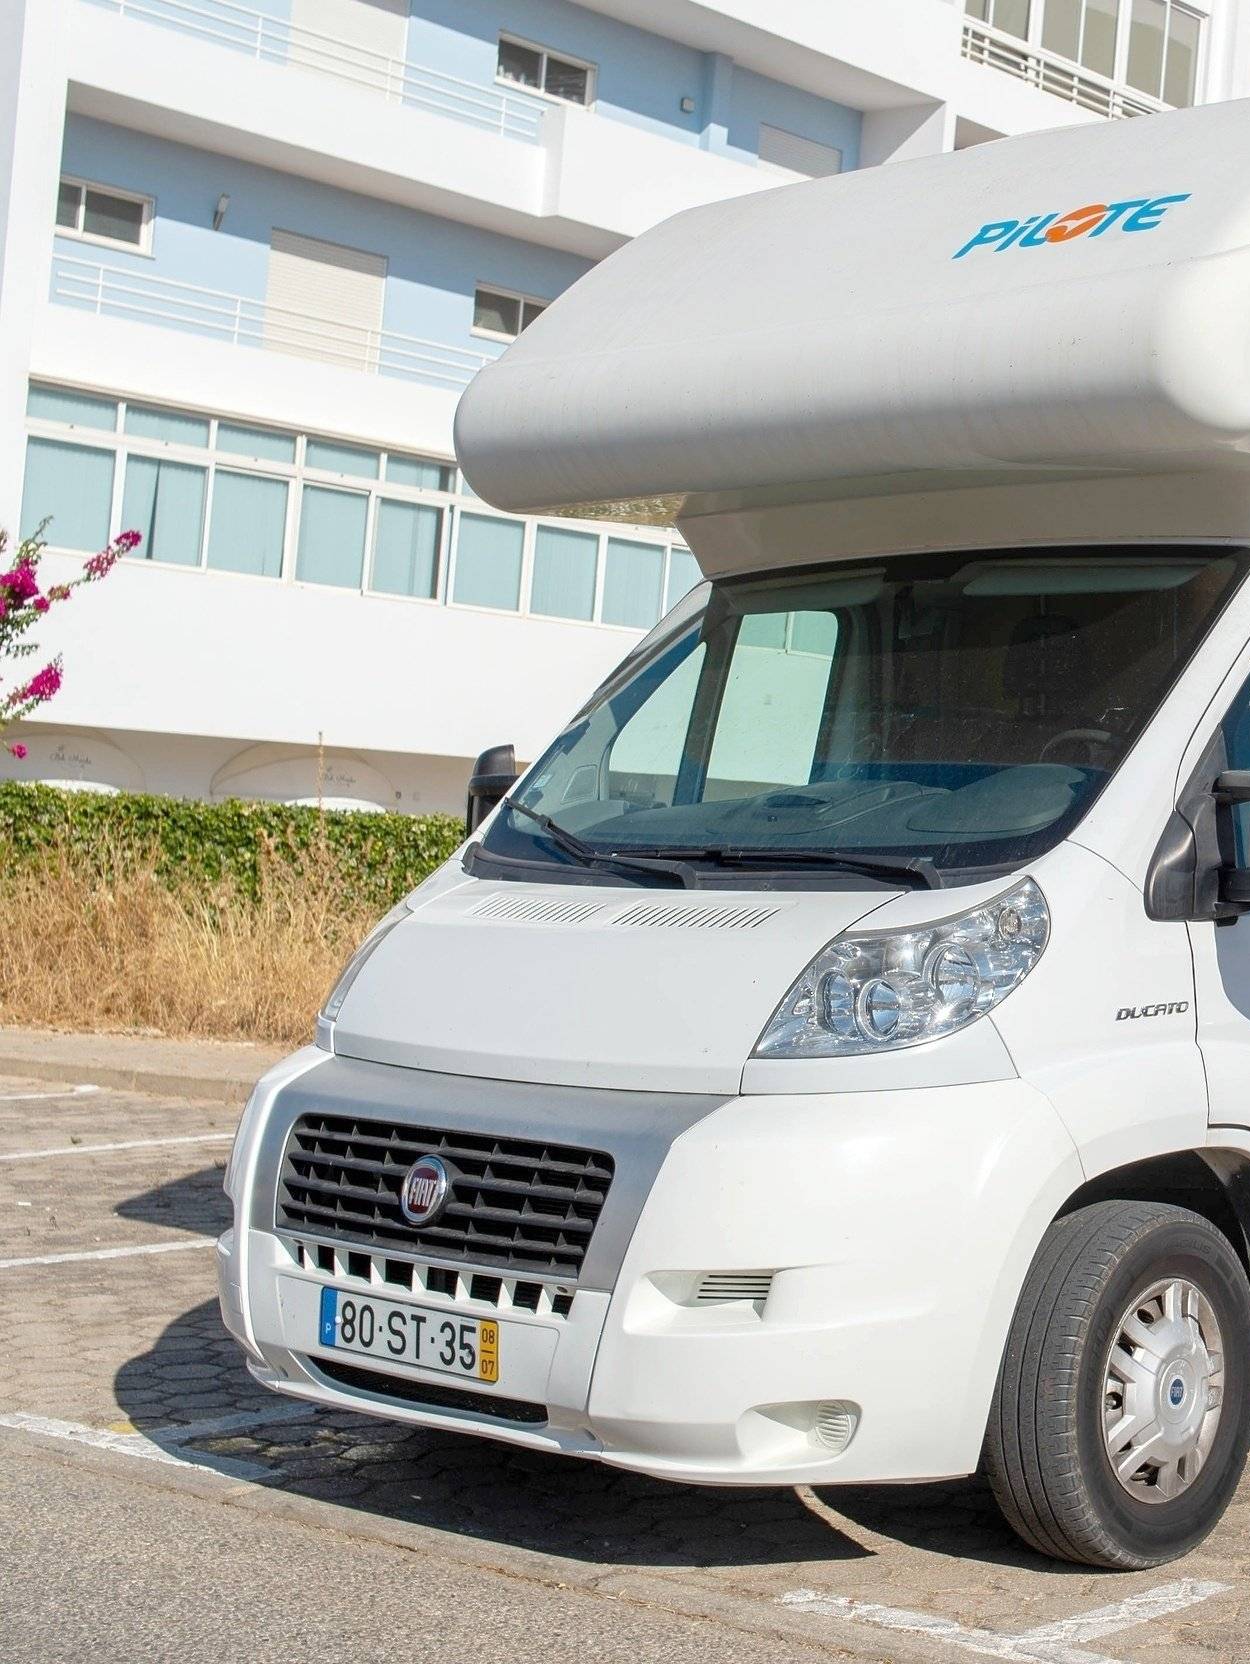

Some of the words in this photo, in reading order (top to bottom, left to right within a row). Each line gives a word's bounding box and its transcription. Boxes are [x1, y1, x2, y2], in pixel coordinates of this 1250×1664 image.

[1115, 1001, 1189, 1021] DUCATO
[408, 1177, 437, 1207] FIAT
[325, 1322, 332, 1334] P
[481, 1327, 495, 1345] 08
[481, 1359, 495, 1376] 07
